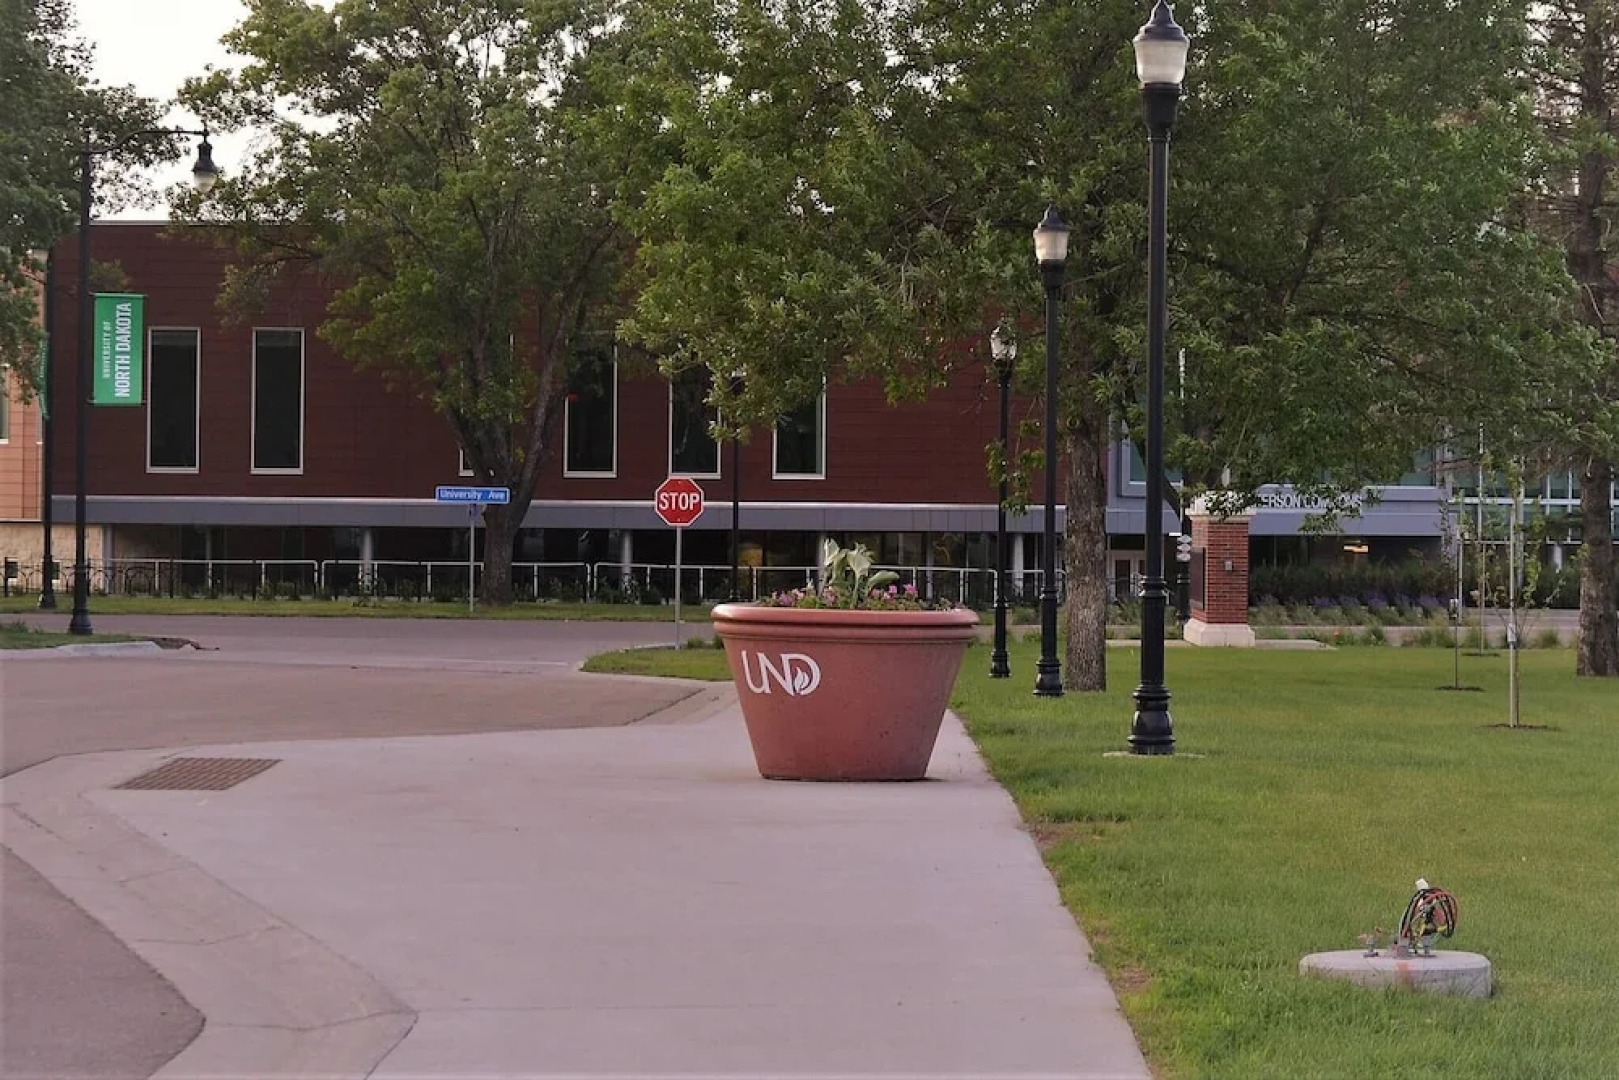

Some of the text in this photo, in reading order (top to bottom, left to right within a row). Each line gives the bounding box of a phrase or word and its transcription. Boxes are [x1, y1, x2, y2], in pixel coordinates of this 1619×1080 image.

[103, 321, 111, 378] UNIVERSITY OF
[115, 303, 131, 398] NORTH DAKOTA
[440, 489, 505, 500] University Ave
[659, 492, 700, 510] STOP
[741, 650, 821, 697] UND
